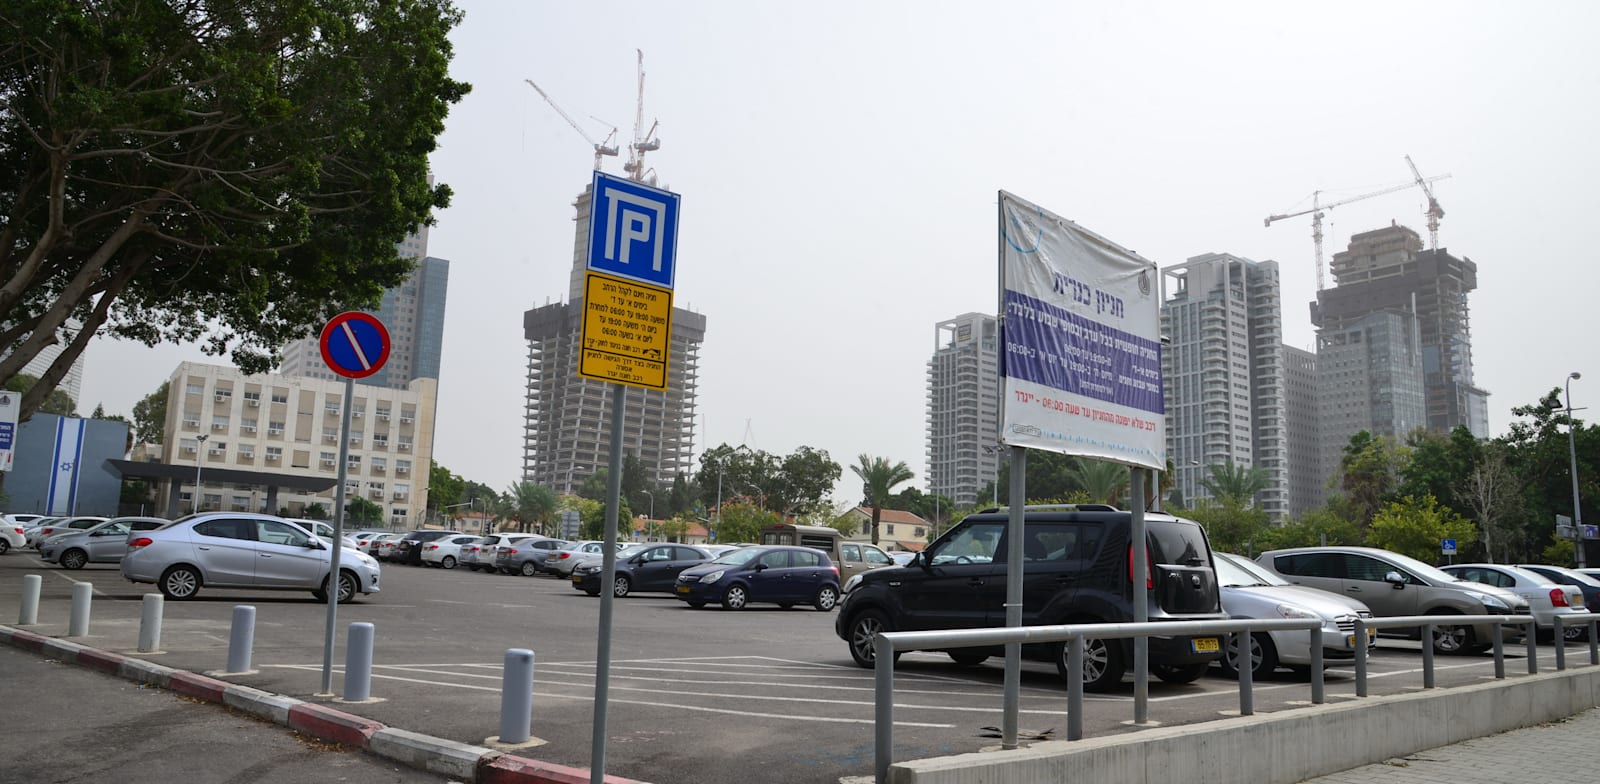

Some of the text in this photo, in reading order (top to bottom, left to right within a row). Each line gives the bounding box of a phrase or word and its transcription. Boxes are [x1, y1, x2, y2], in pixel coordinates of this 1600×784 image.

[619, 209, 651, 264] P
[1096, 289, 1124, 319] חניון
[610, 307, 625, 316] 06:00
[1038, 311, 1058, 328] שבוע
[602, 328, 617, 336] 06:00
[1084, 328, 1098, 343] ערב
[1100, 331, 1113, 347] בכל
[1114, 338, 1139, 356] חופשית
[1065, 403, 1080, 415] שעה
[1082, 407, 1090, 418] עד
[1132, 417, 1144, 430] שלא
[1145, 421, 1156, 432] רכב
